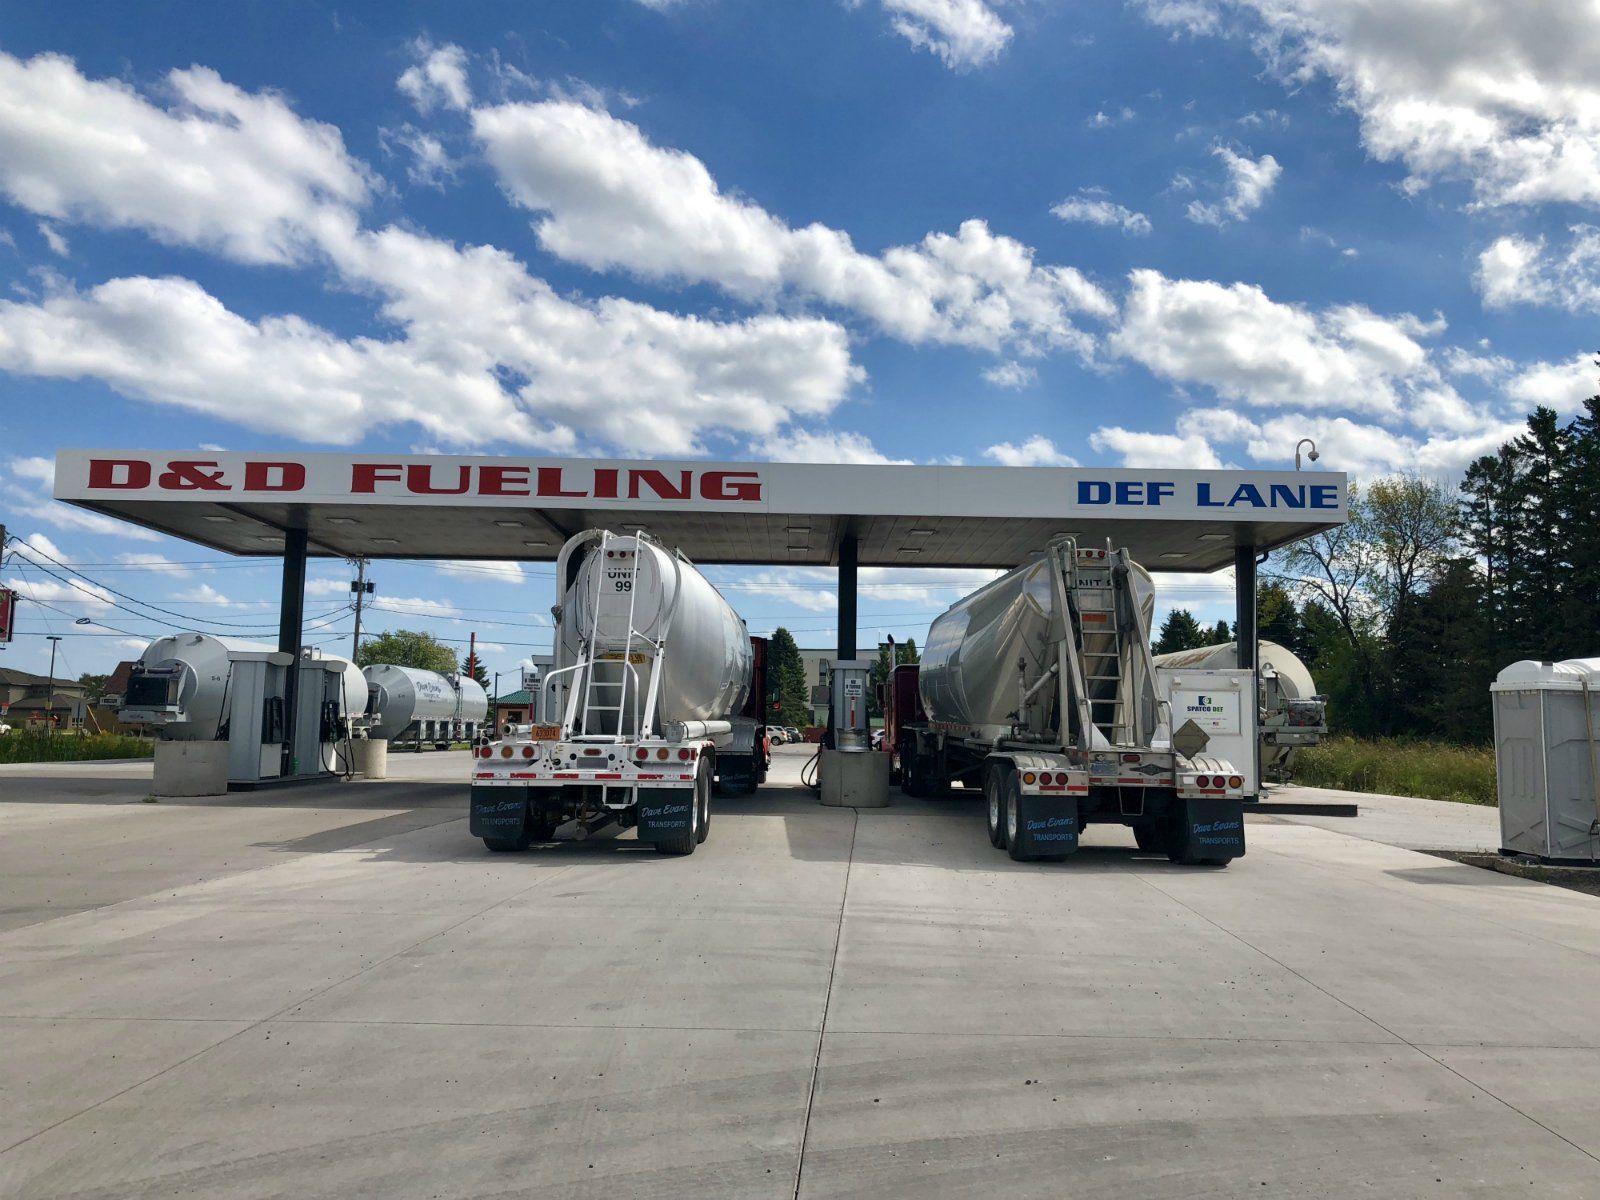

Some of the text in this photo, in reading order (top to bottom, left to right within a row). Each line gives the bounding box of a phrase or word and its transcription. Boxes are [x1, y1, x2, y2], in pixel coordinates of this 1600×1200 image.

[87, 459, 762, 501] D&D FUELING
[1077, 481, 1339, 509] DEF LANE
[608, 567, 641, 579] UNIT
[615, 581, 632, 592] 99
[641, 804, 689, 818] Dave Evans
[647, 820, 686, 828] TRANSPORTS
[1027, 817, 1074, 830] Dave Evans
[1193, 821, 1240, 834] Dave Evans
[1033, 833, 1073, 841] TRANSPORTS
[1199, 837, 1239, 845] TRANSPORTS
